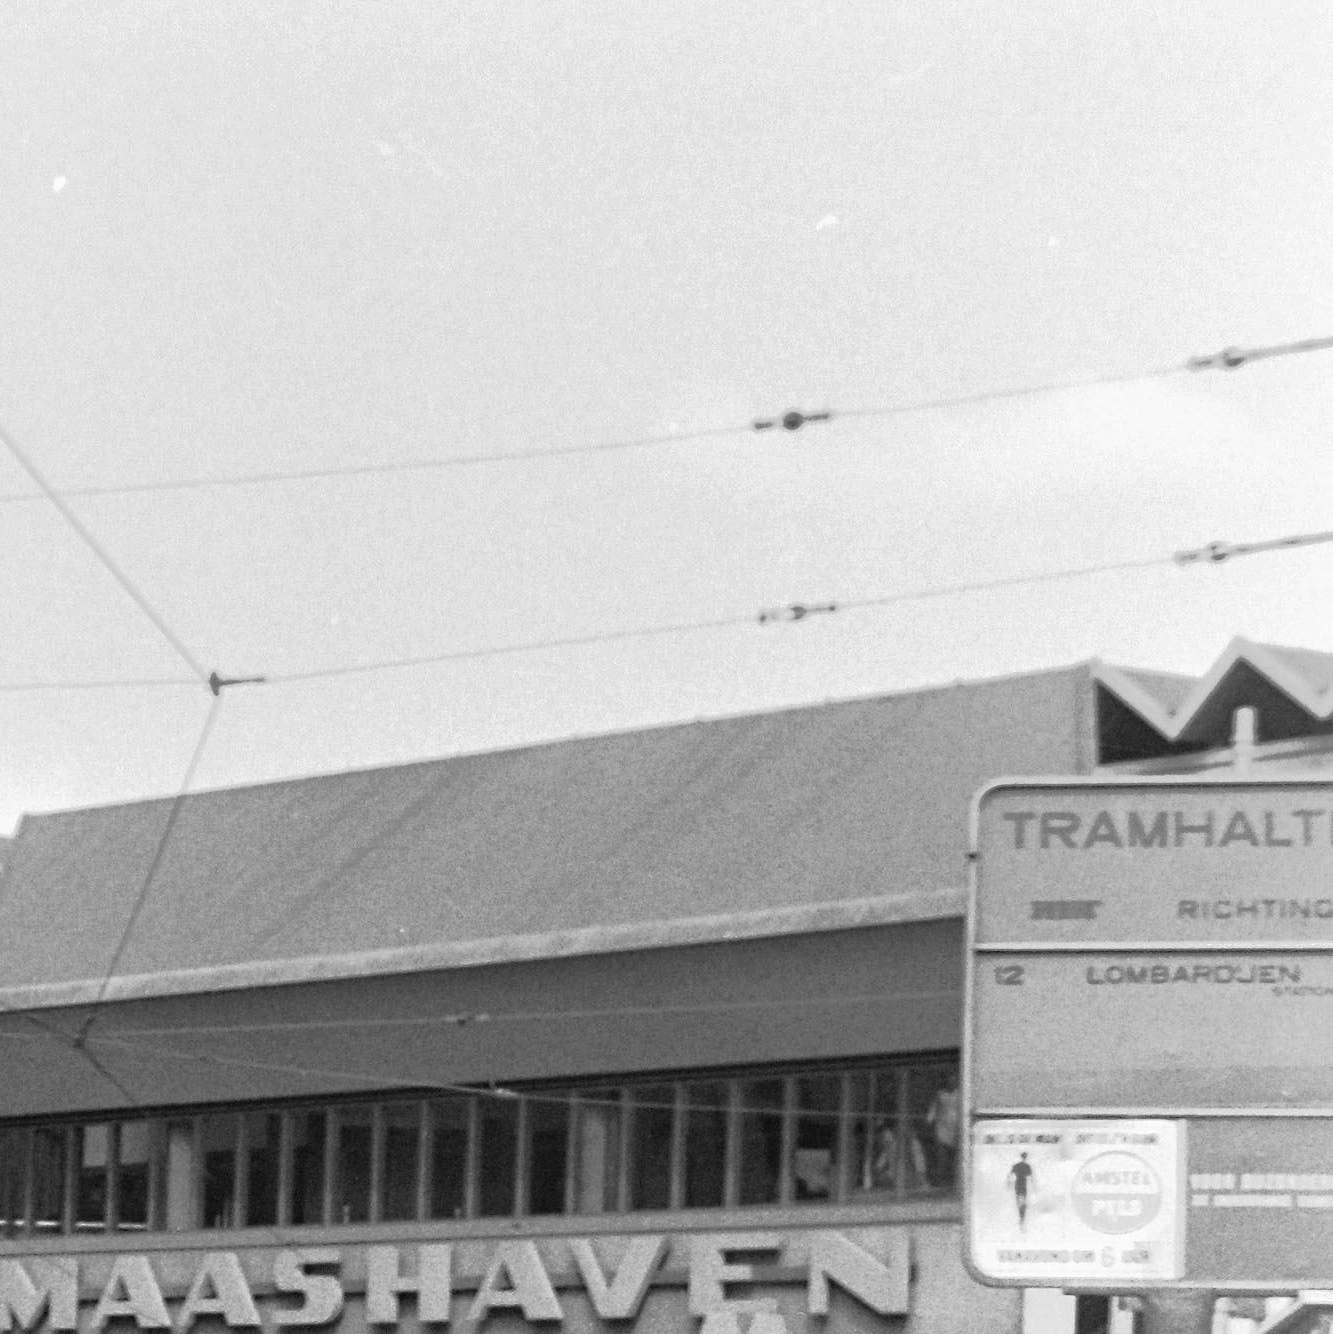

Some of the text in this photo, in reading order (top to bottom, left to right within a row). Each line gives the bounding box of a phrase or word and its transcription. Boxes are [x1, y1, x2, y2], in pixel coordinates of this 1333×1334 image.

[1003, 809, 1333, 849] TRAMHALT
[994, 965, 1025, 986] 12
[1082, 1170, 1152, 1185] AMSTEL
